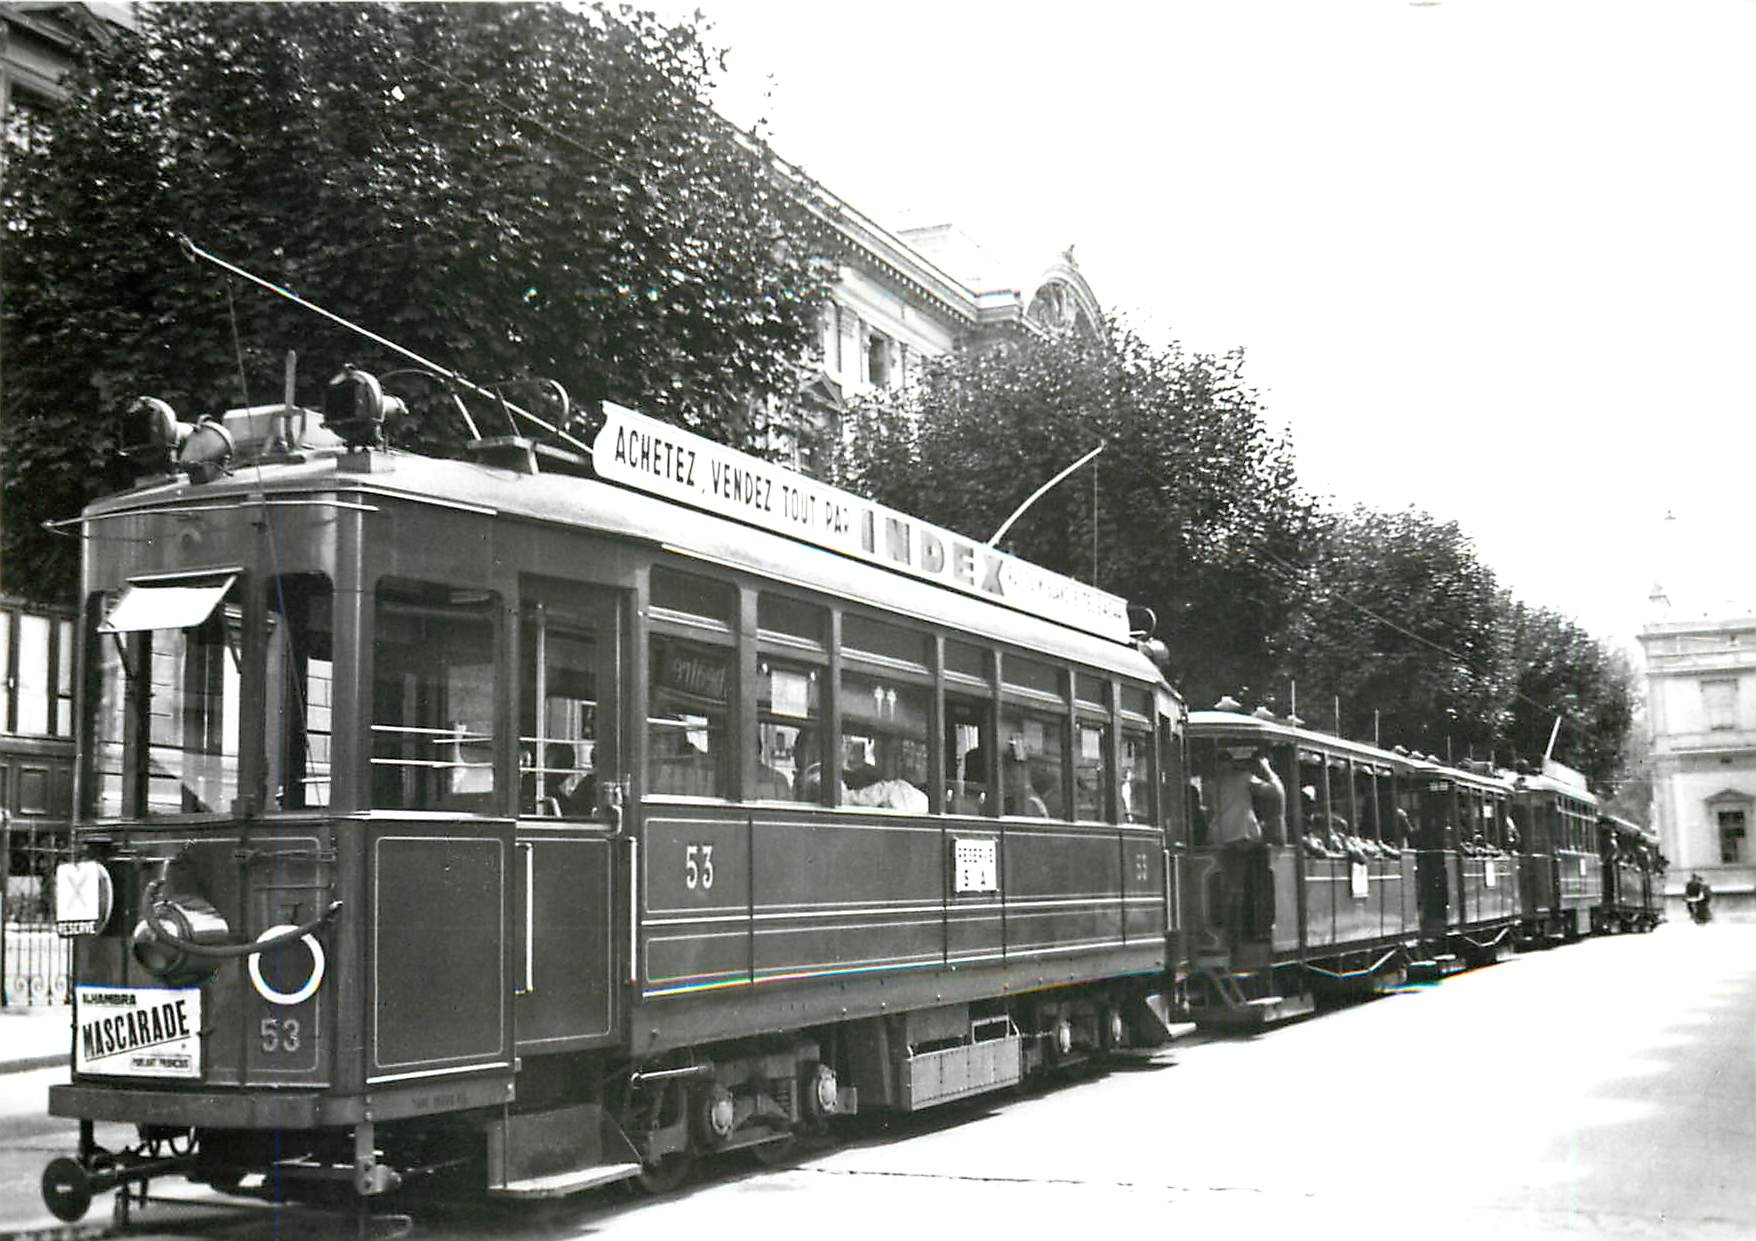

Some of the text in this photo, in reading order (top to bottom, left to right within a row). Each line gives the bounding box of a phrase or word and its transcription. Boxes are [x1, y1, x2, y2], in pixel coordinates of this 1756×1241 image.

[711, 458, 772, 512] VENDEZ
[782, 484, 816, 528] TOUT
[861, 508, 1005, 597] INDEX
[686, 845, 714, 889] 53
[83, 999, 190, 1059] MASCARADE
[260, 1017, 301, 1052] 53
